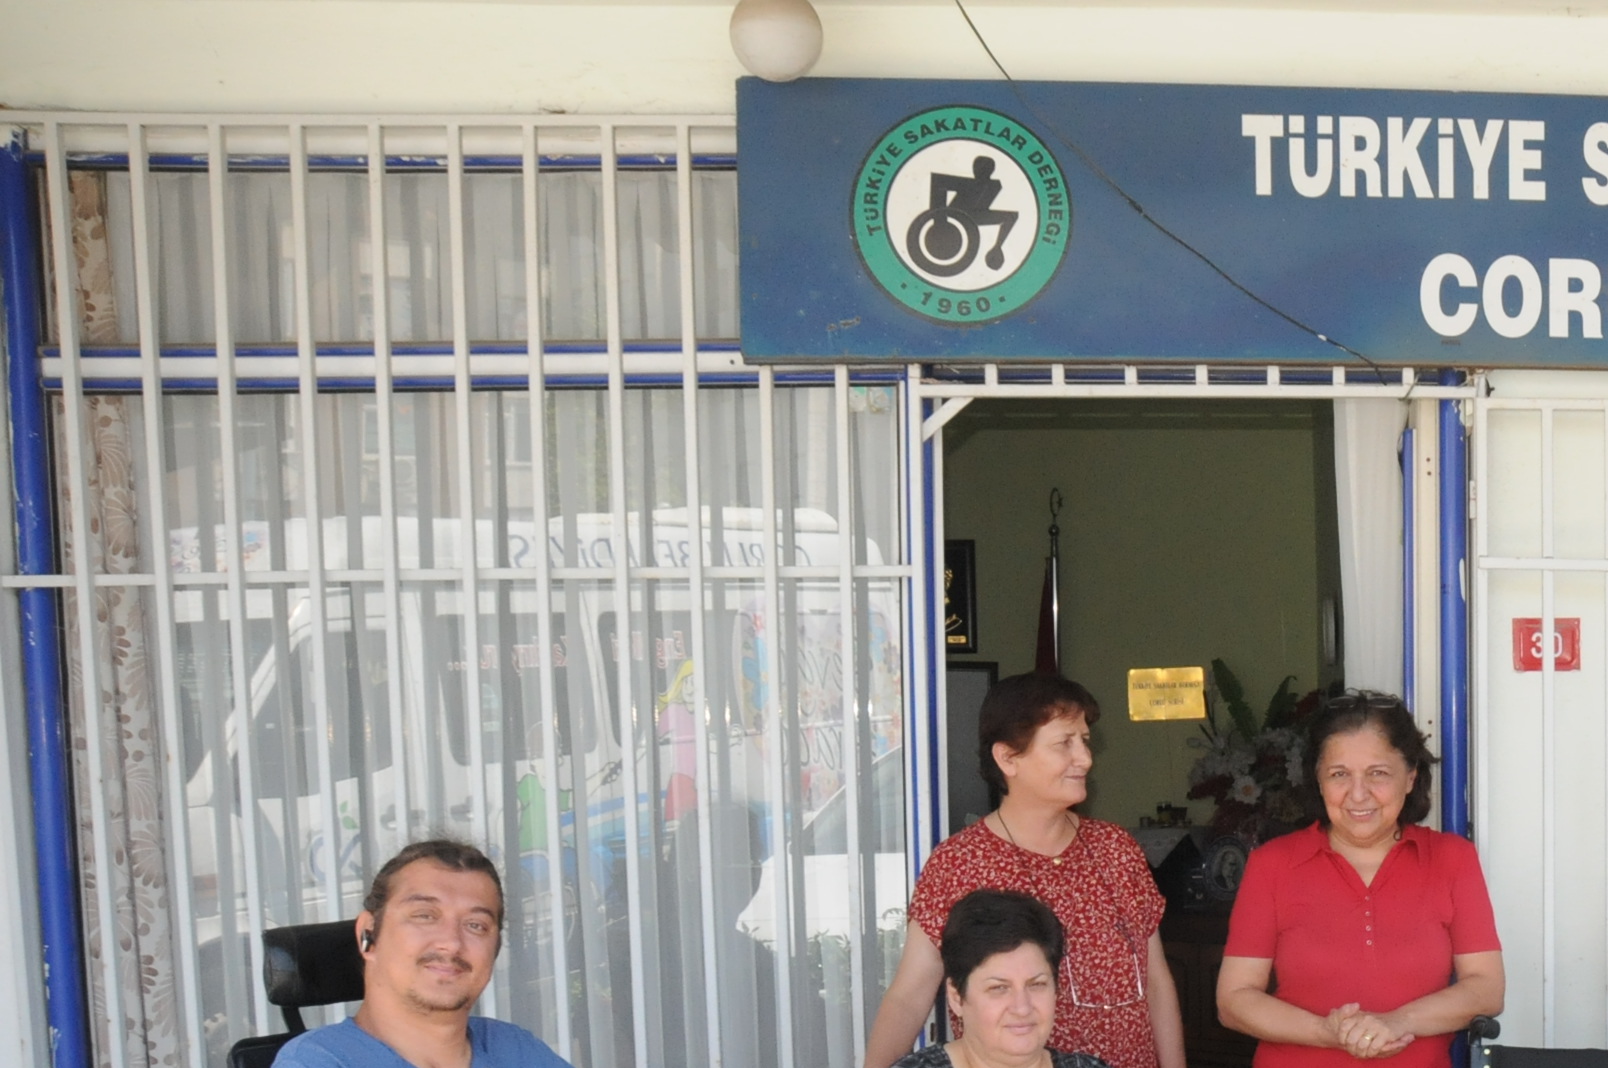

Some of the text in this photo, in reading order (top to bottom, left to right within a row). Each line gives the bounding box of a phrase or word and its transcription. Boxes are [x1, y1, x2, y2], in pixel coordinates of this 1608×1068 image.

[903, 118, 1028, 151] SAKATLAR
[920, 291, 992, 317] 1960
[1529, 631, 1563, 659] 30
